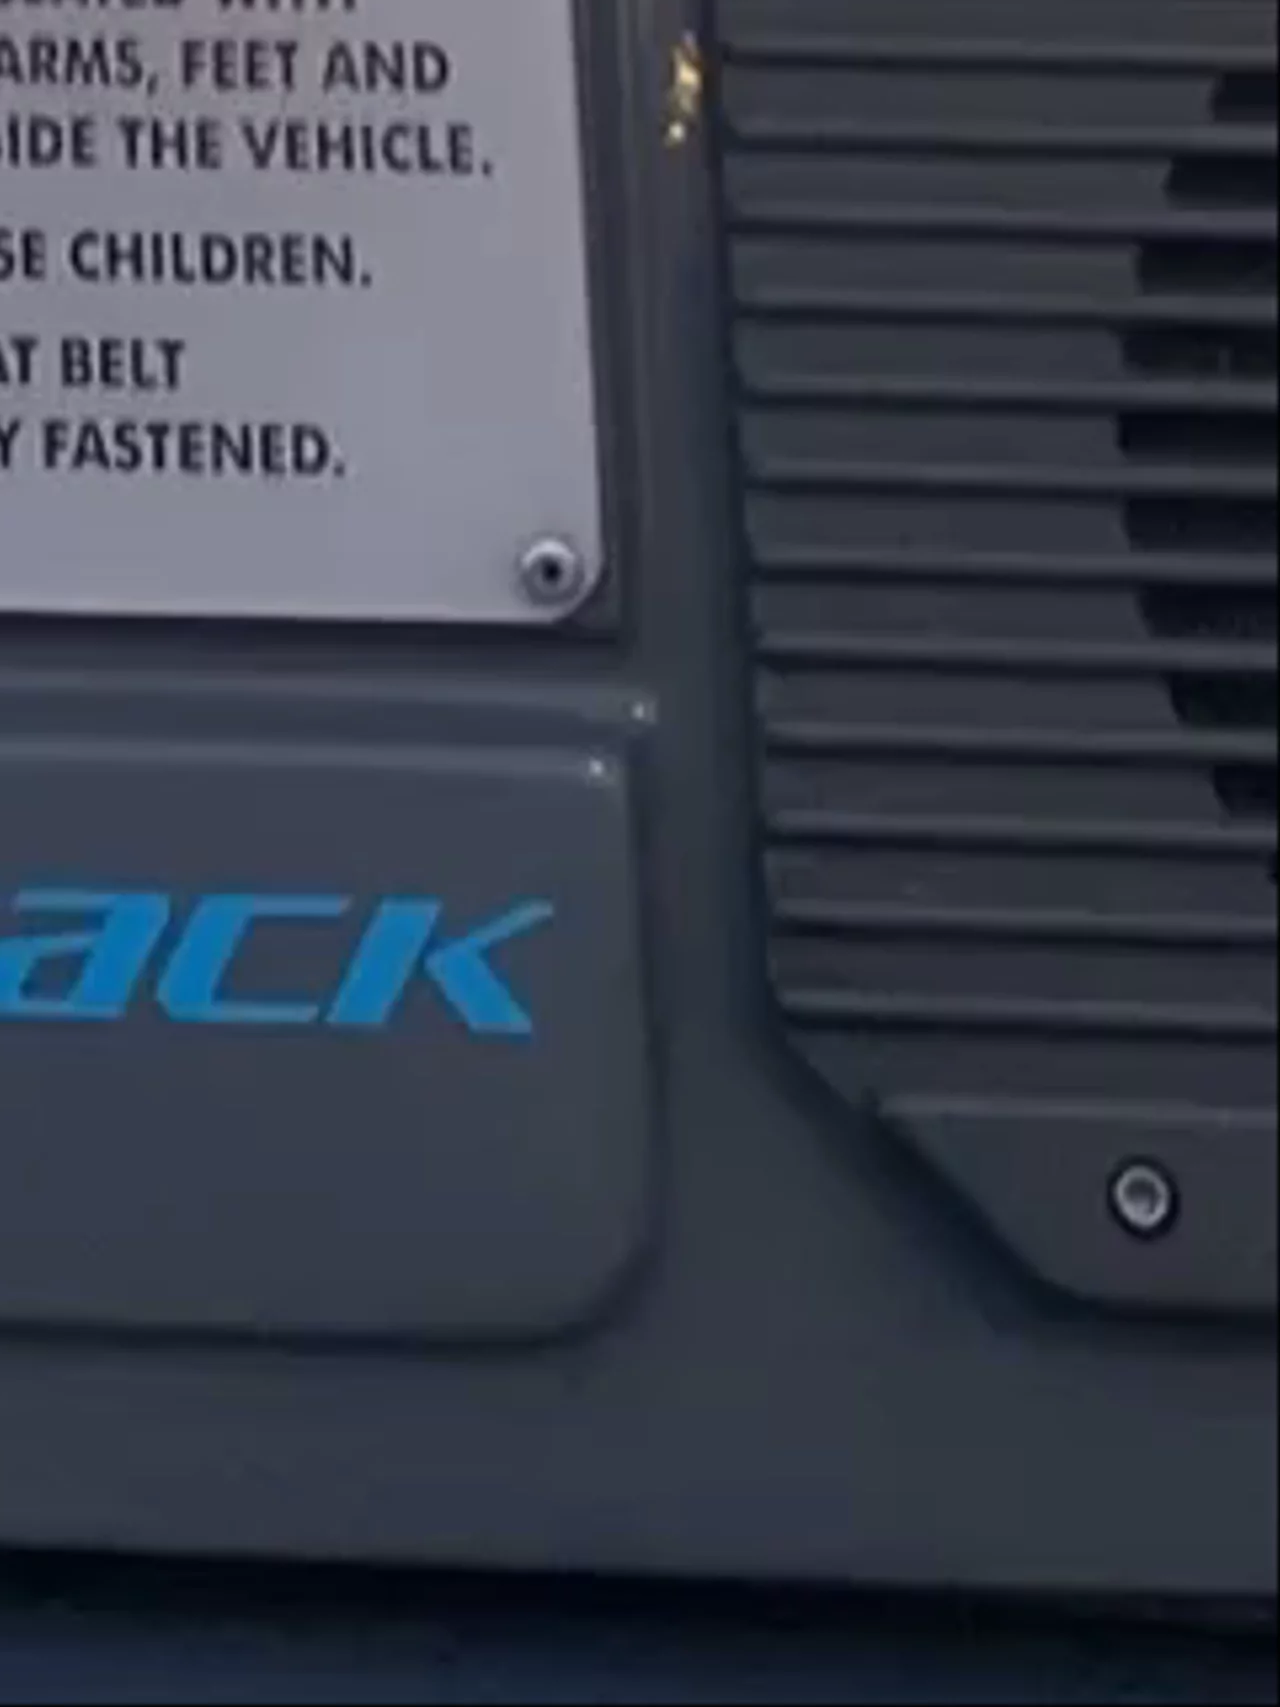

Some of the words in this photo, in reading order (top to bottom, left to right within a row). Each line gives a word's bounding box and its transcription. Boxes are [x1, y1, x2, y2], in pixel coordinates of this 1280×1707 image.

[180, 38, 299, 93] FEET
[321, 39, 451, 95] AND
[117, 115, 222, 171] THE
[240, 119, 493, 177] VEHICLE.
[68, 228, 372, 287] CHILDREN.
[59, 336, 186, 391] BELT
[42, 417, 345, 477] FASTENED.
